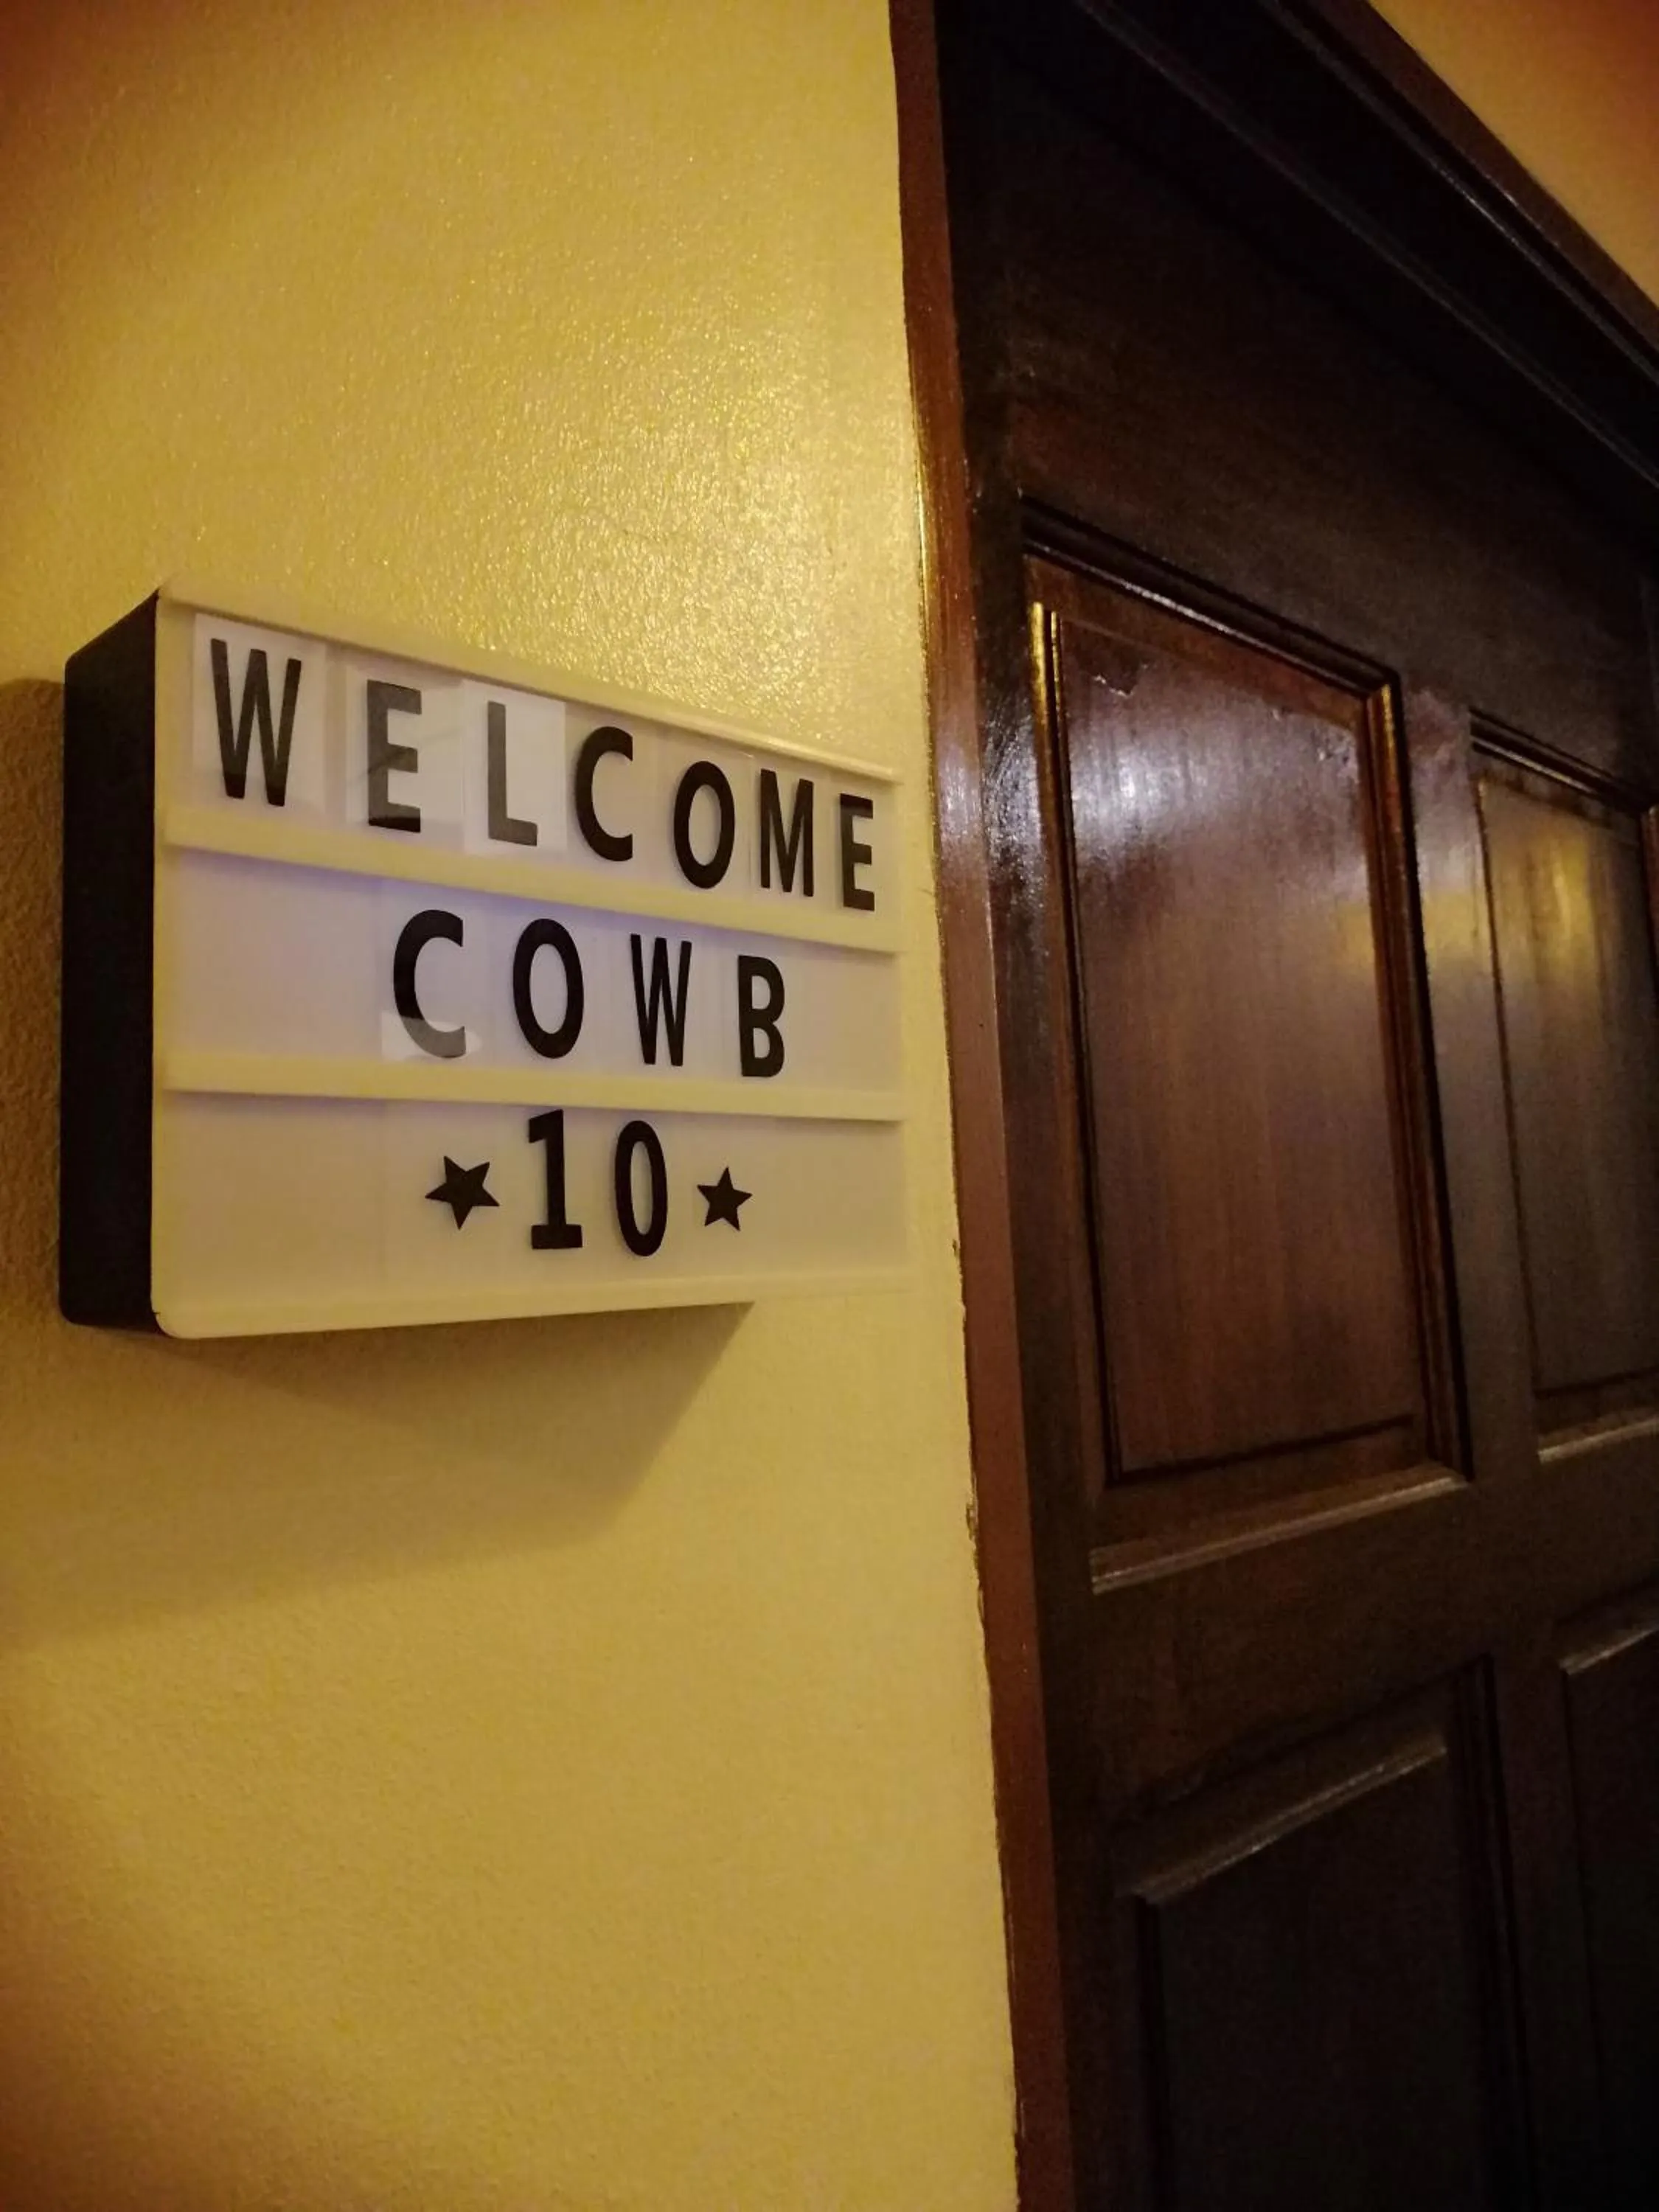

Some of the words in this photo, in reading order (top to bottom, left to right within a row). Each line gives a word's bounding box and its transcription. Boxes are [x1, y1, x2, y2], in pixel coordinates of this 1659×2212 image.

[209, 637, 876, 913] WELCOME
[392, 908, 786, 1079] COWB
[526, 1107, 669, 1258] 10
